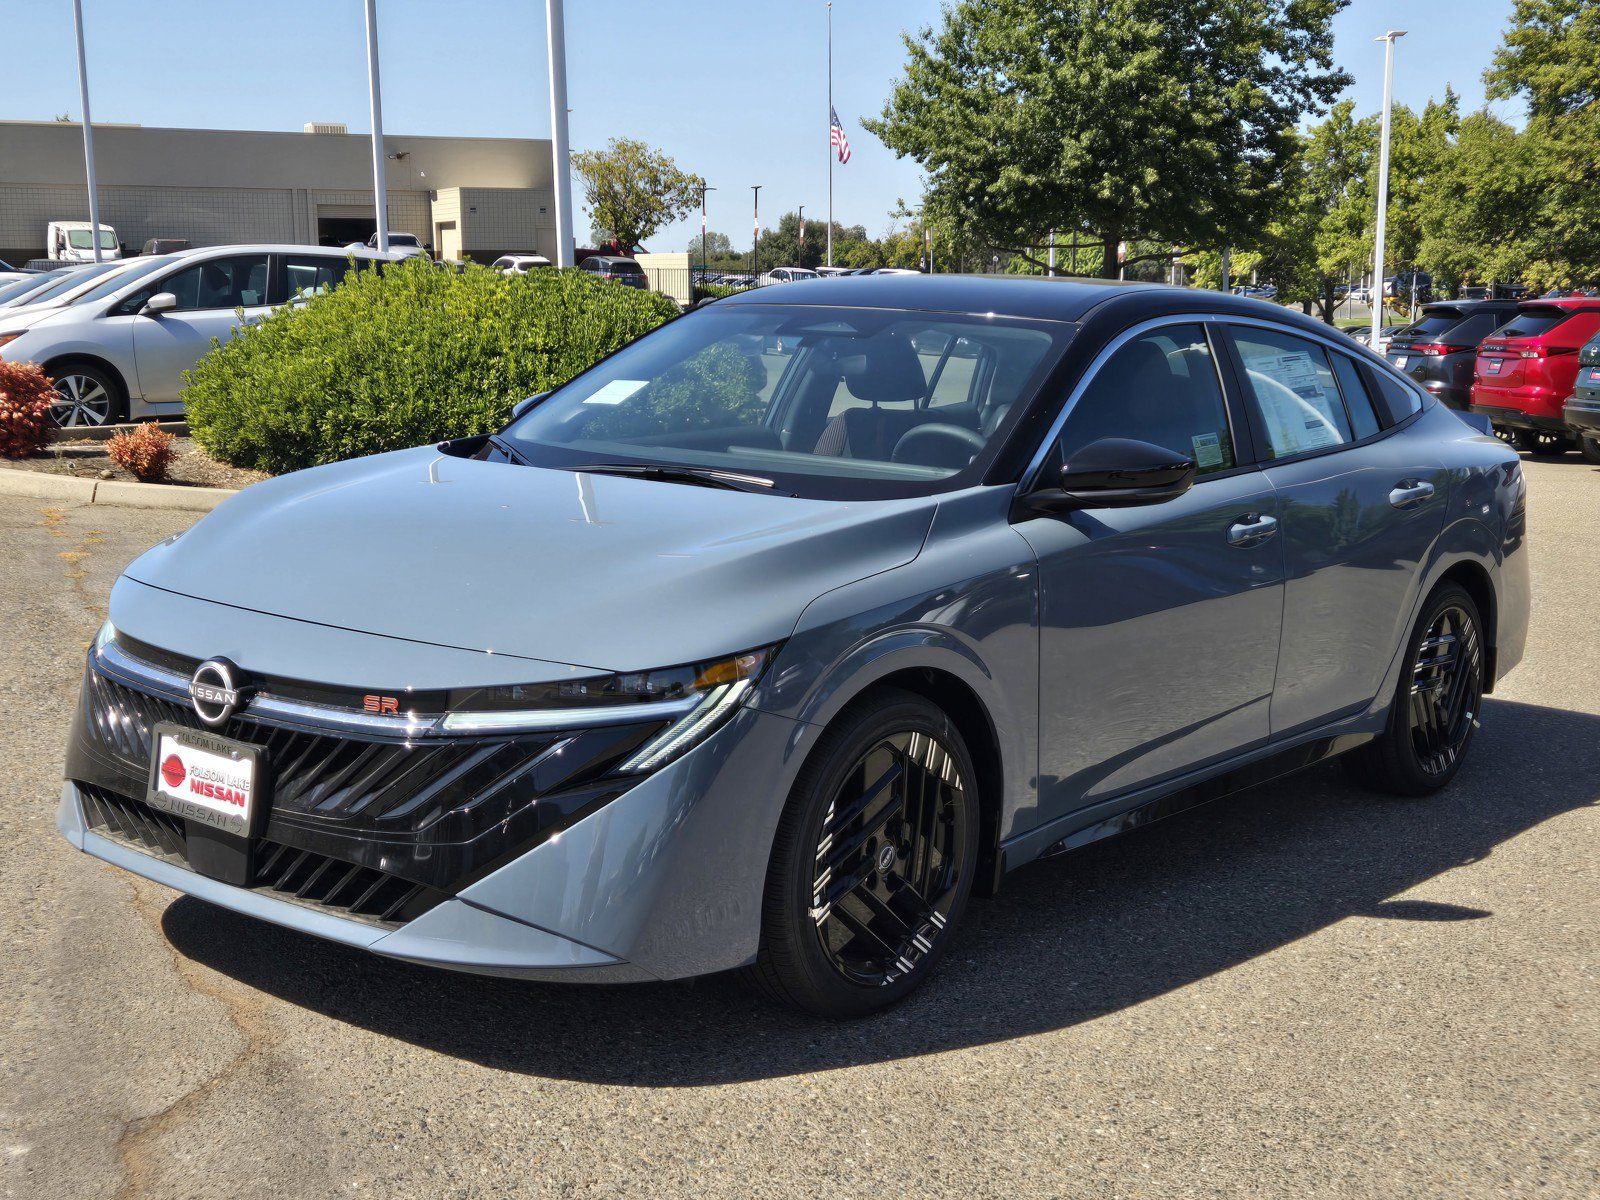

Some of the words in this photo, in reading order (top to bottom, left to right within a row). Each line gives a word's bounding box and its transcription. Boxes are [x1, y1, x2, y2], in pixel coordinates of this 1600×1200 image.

[189, 684, 236, 704] NISSAN
[363, 694, 399, 716] SR
[178, 731, 210, 749] FOLSOM
[211, 740, 232, 755] LAKE
[189, 764, 225, 783] FOLSOM
[226, 773, 251, 791] LAKE
[190, 780, 245, 808] NISSAN
[170, 799, 227, 826] NISSAN
